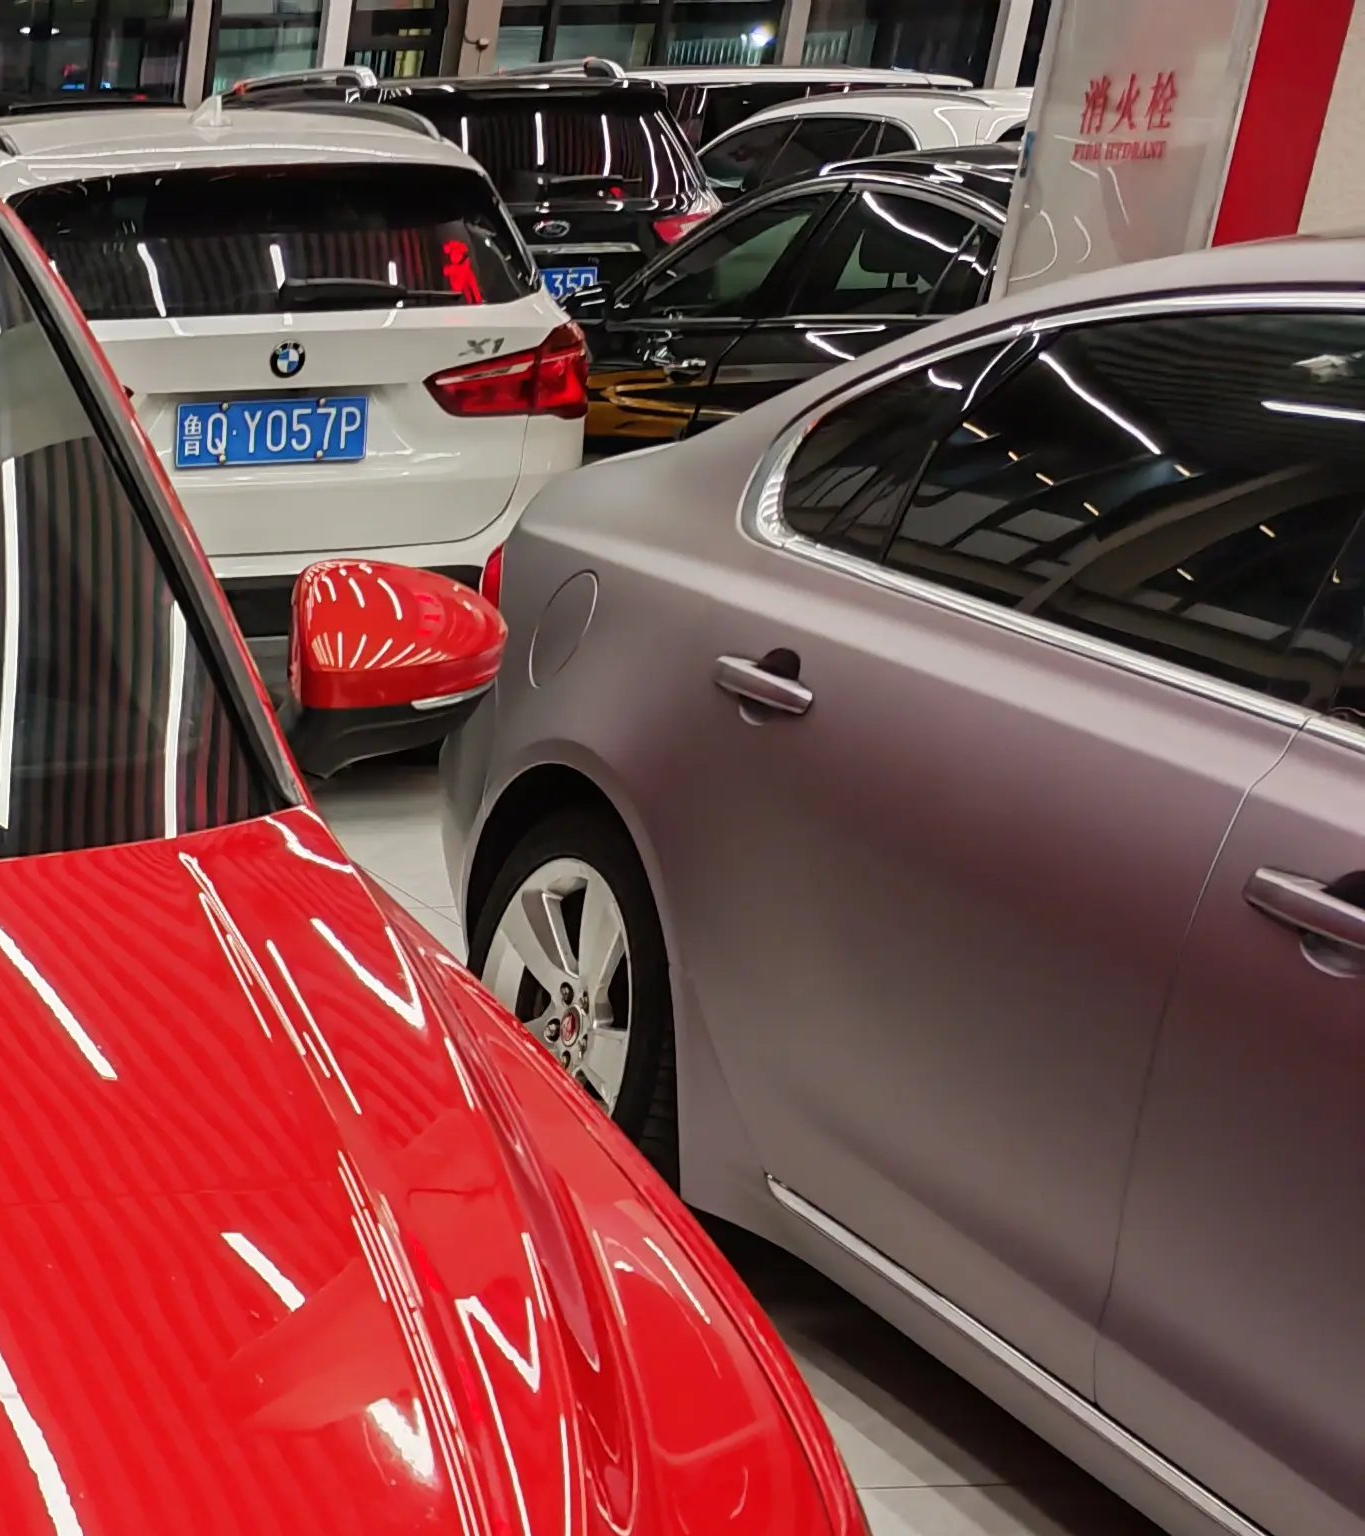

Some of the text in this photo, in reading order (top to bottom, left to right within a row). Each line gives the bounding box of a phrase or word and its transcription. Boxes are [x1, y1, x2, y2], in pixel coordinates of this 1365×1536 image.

[1079, 70, 1178, 135] 消火栓
[1104, 140, 1167, 160] HYDRANT
[458, 336, 505, 357] X1
